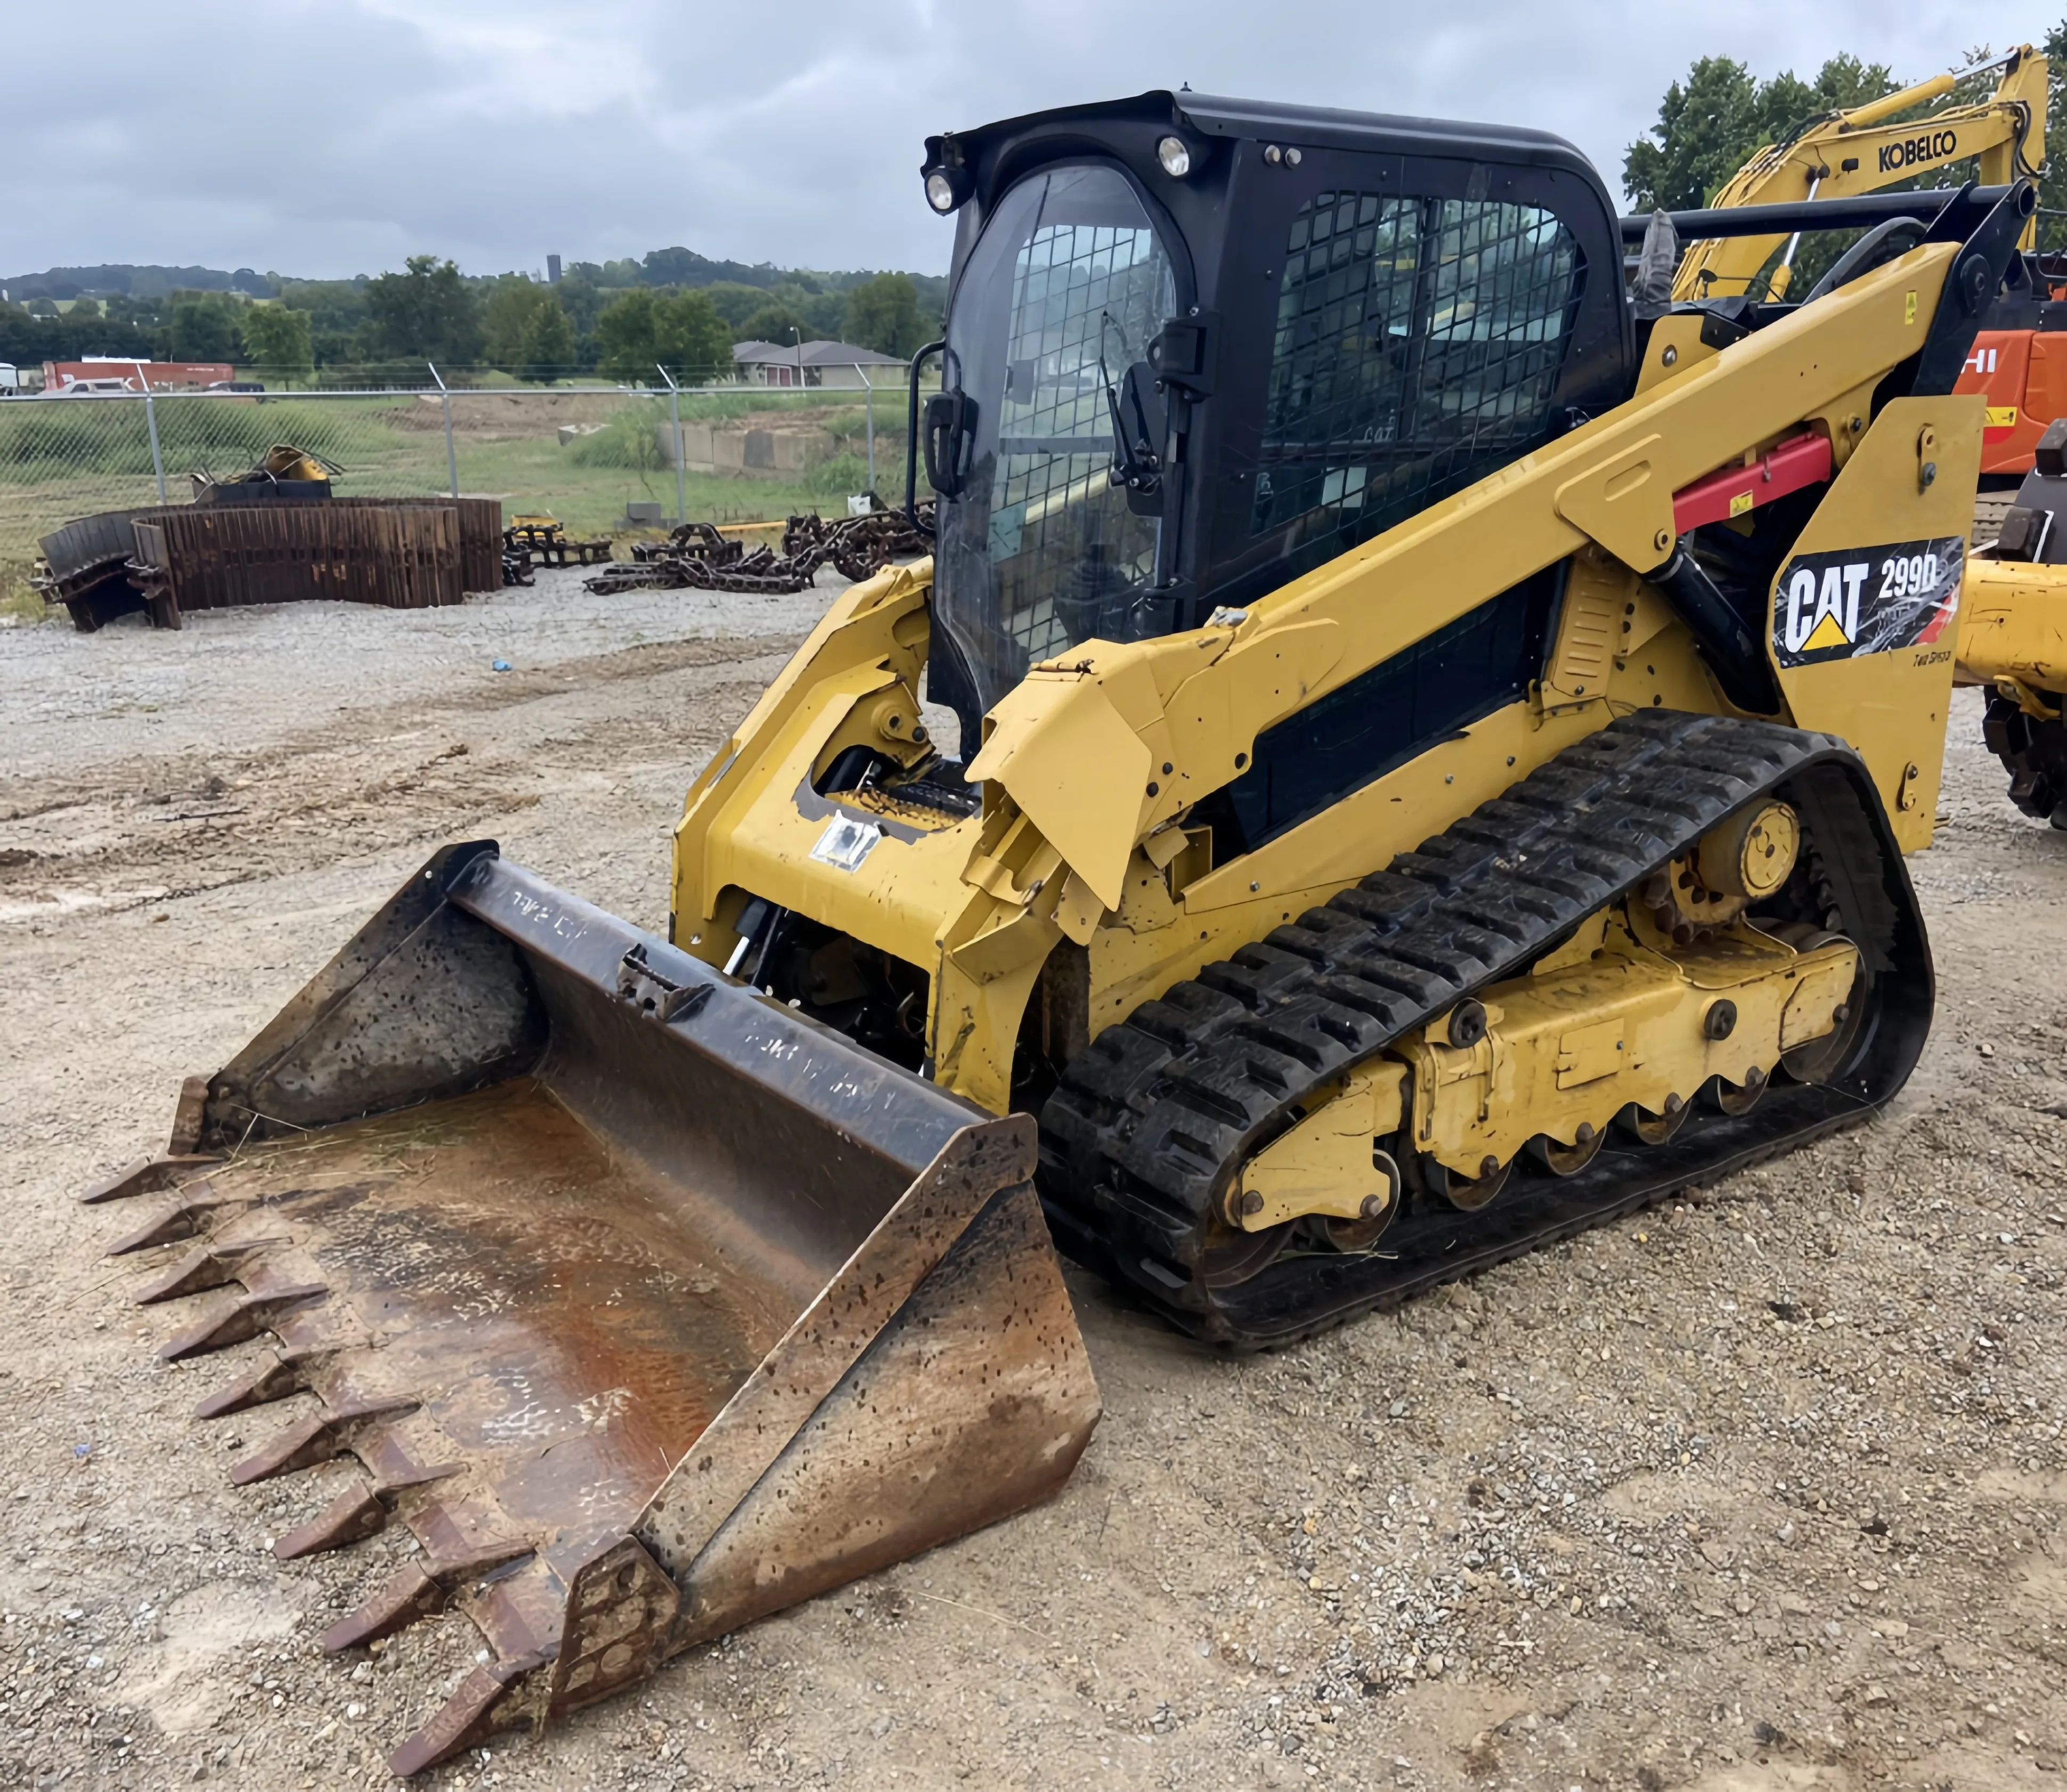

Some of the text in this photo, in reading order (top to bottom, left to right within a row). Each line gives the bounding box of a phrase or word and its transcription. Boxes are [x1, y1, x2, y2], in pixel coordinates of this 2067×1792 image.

[1879, 130, 1957, 173] KOBELCO
[1785, 554, 1938, 653] CAT 299D
